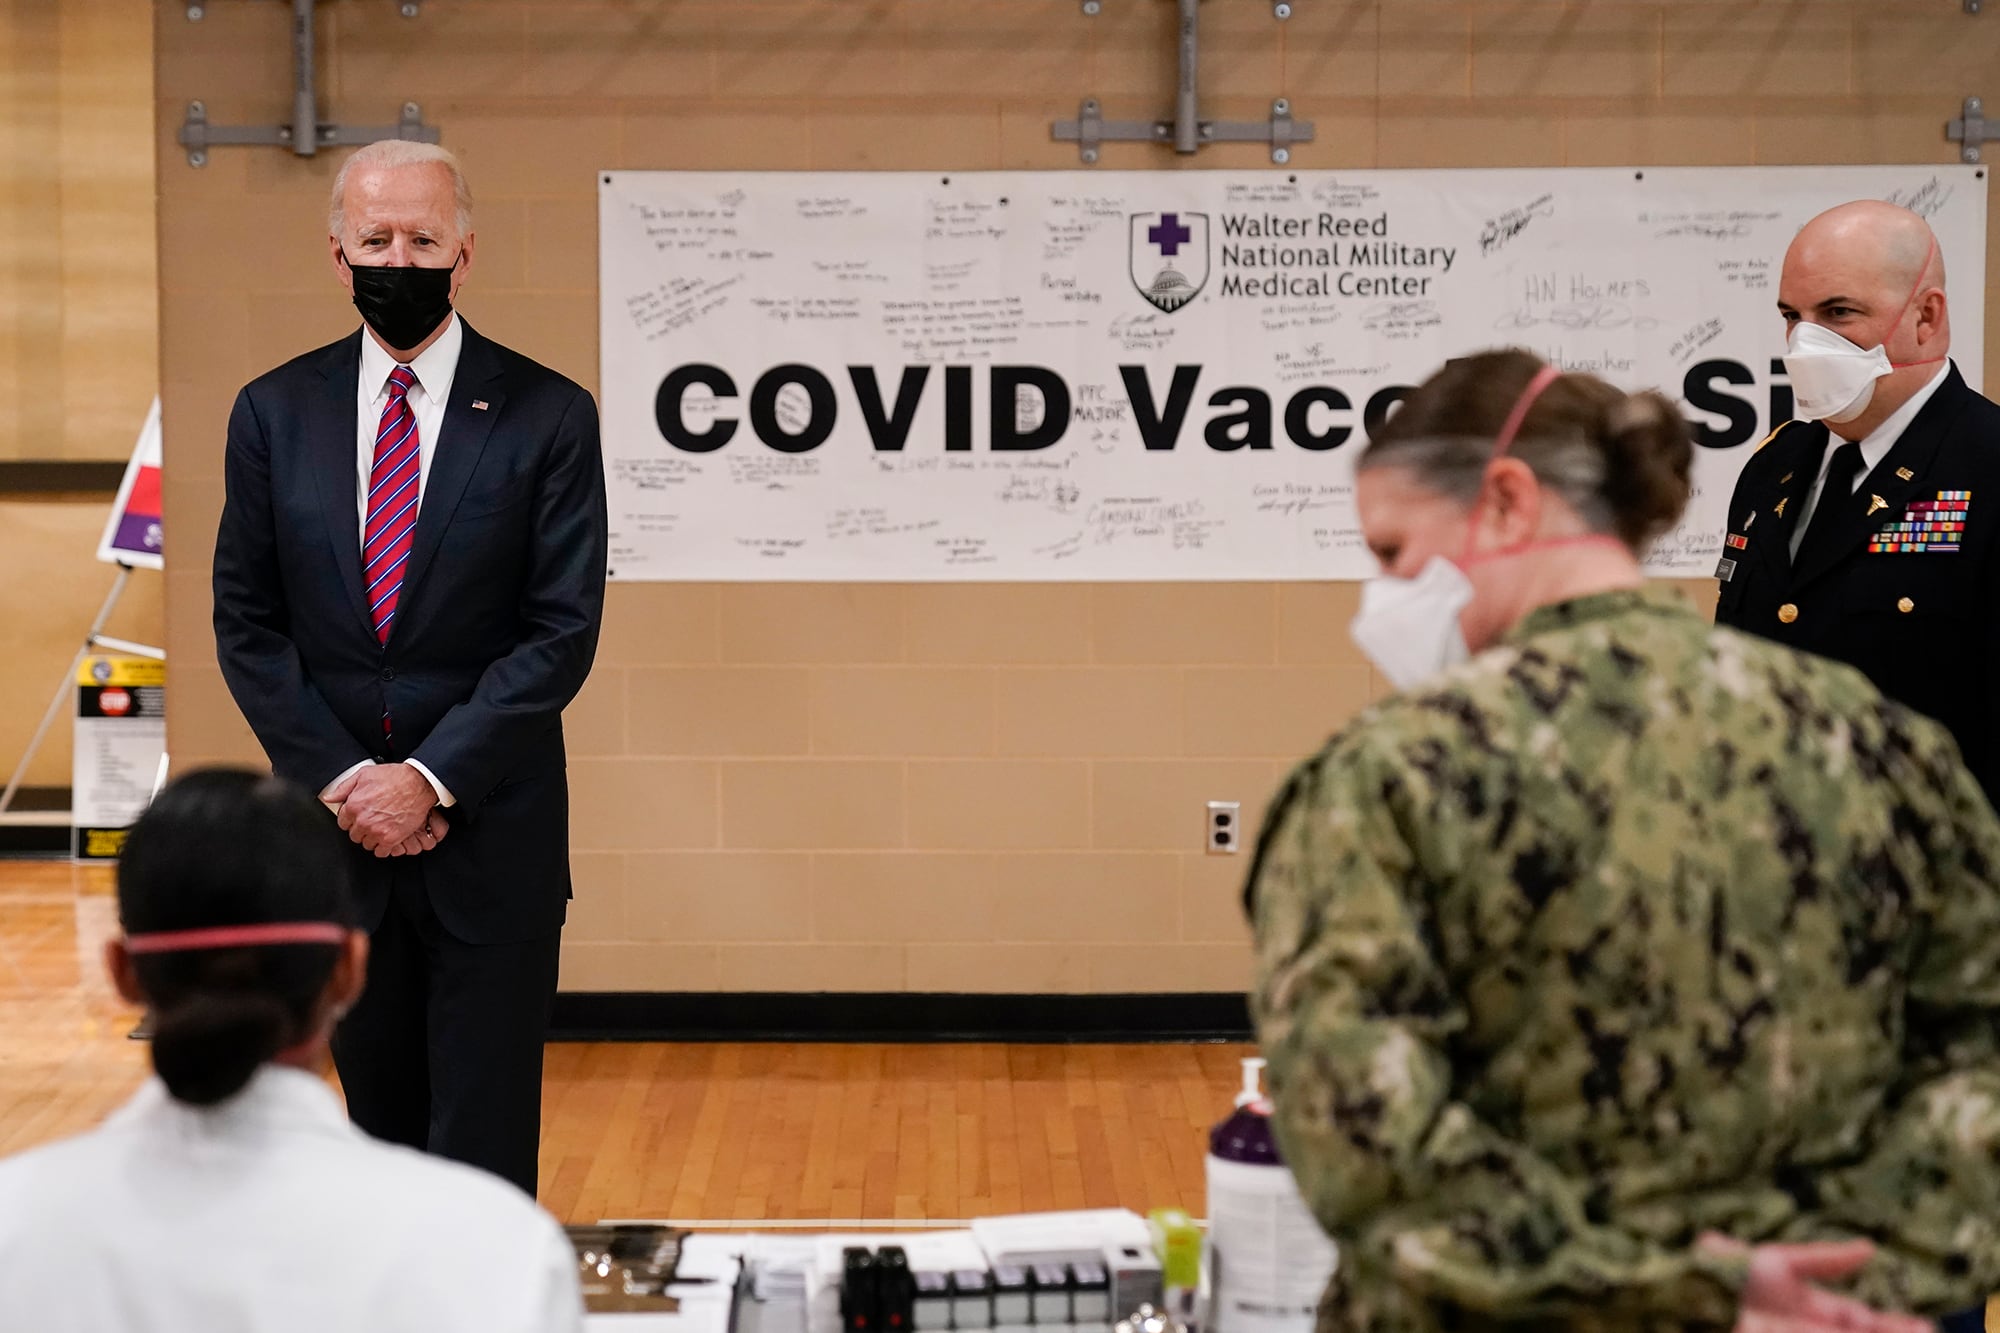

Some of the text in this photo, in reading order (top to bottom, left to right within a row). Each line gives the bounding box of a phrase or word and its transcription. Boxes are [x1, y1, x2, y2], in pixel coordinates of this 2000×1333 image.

[1221, 212, 1387, 237] Walter Reed
[1222, 242, 1456, 273] National Military
[1221, 271, 1431, 297] Medical Center
[655, 363, 1071, 453] COVID
